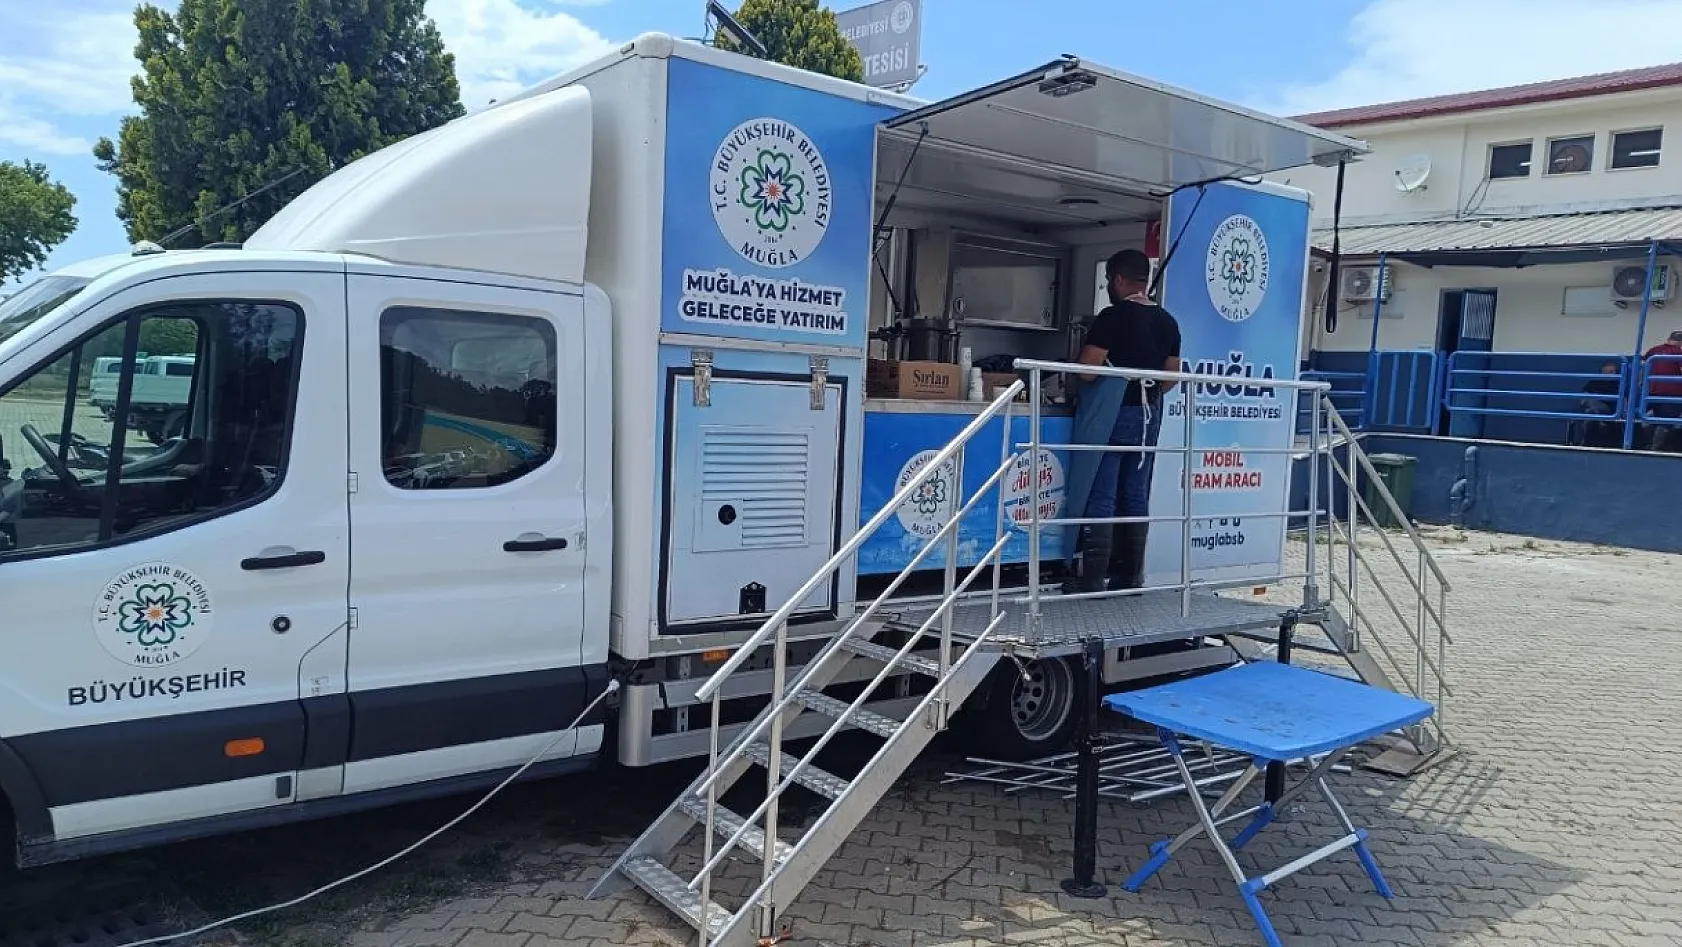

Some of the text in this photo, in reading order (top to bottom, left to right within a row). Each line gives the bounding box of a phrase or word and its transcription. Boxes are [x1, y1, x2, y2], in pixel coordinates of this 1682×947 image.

[864, 42, 909, 76] TESİSİ
[714, 122, 830, 227] T.C. BÜYÜKŞEHİR BELEDİYESİ
[741, 241, 798, 265] MUĞLA
[687, 272, 842, 306] MUĞLA'YA HİZMET
[682, 300, 845, 330] GELECEĞE YATIRIM
[1181, 353, 1275, 398] MUĞLA
[1168, 401, 1283, 421] BÜYKŞEHİR BELEDİYESİ
[1224, 472, 1262, 488] ARACI
[1191, 531, 1245, 550] muglabsb
[103, 565, 170, 601] BÜYÜKŞEHİR
[173, 569, 212, 614] BELEDİYESİ
[134, 651, 180, 664] MUĞLA
[68, 667, 246, 706] BÜYÜKŞEHİR
